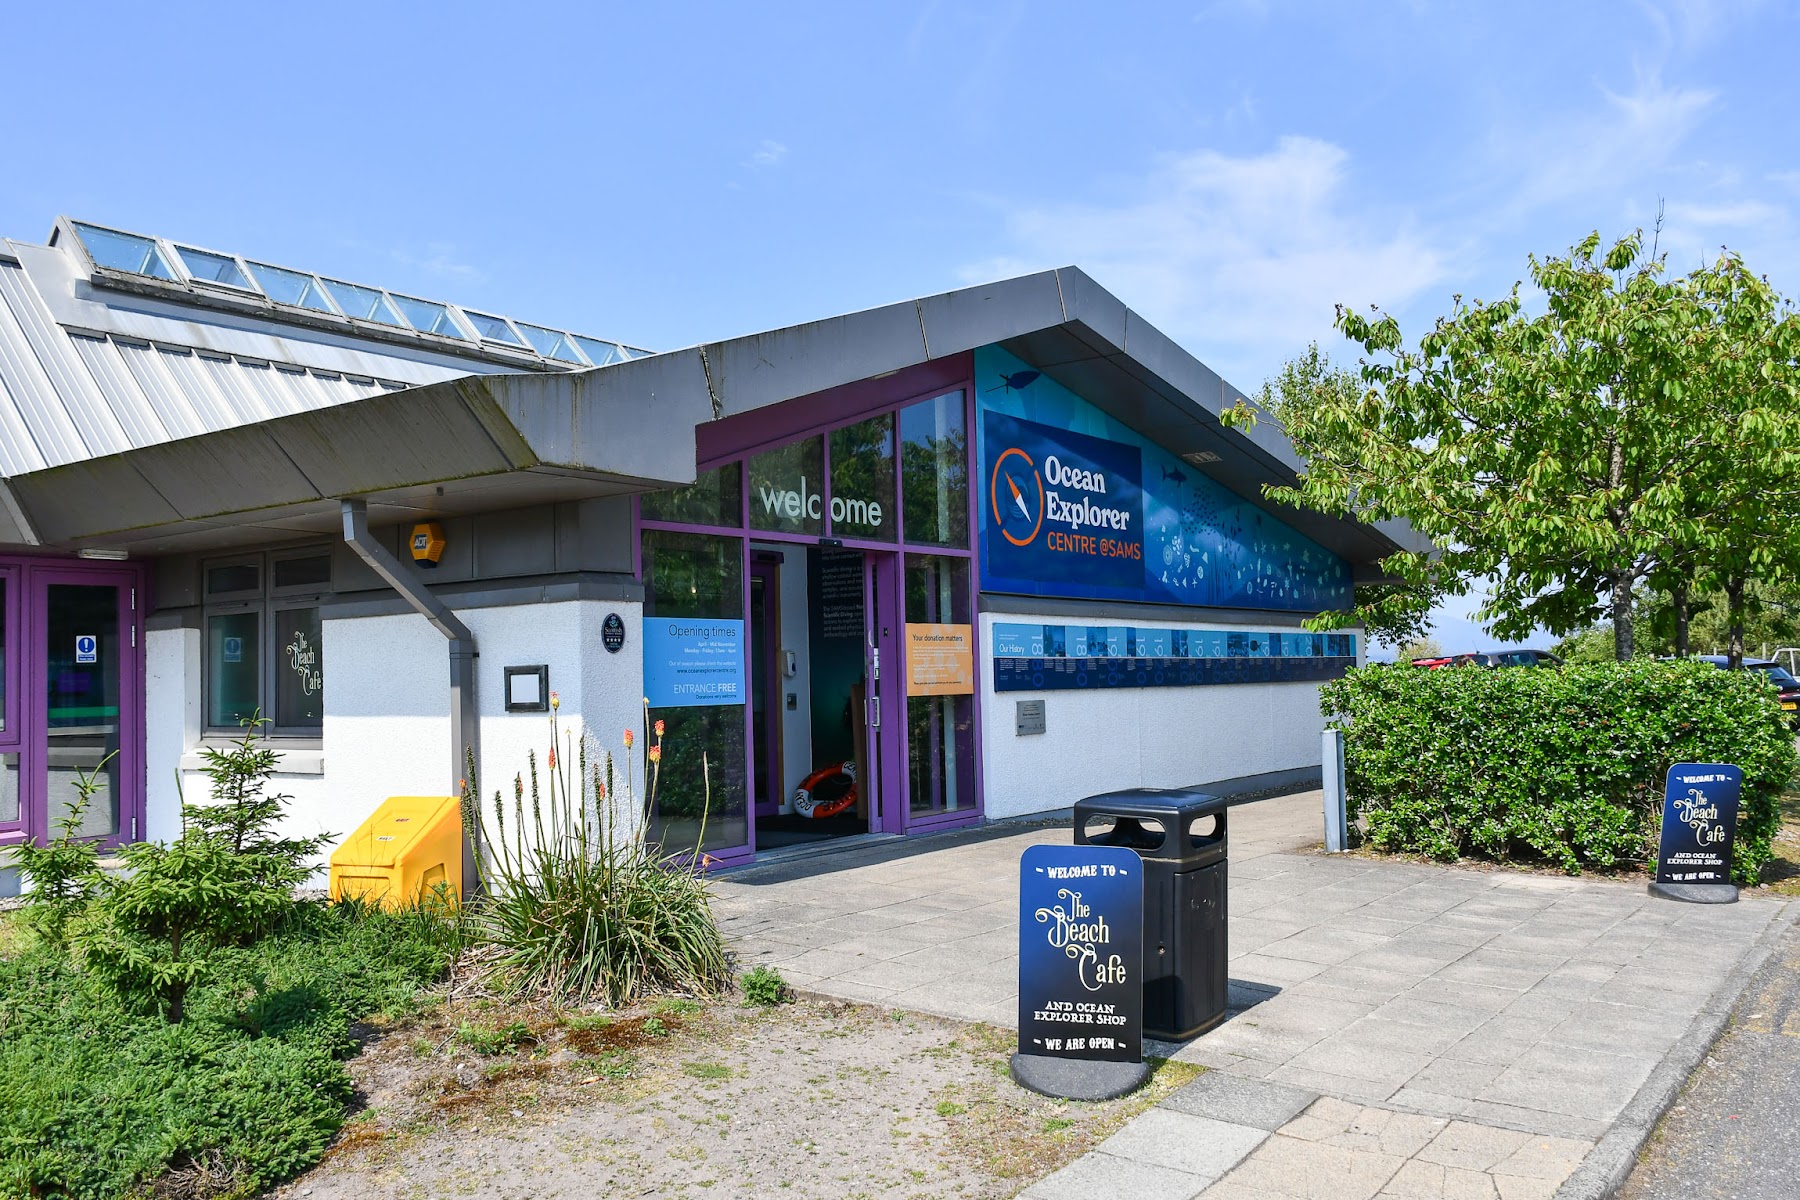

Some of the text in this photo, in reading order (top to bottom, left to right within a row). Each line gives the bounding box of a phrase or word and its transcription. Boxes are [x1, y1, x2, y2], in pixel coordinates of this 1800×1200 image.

[1045, 455, 1106, 494] Ocean
[760, 476, 882, 526] welcome
[1046, 491, 1130, 530] Explorer
[414, 537, 427, 547] ADT
[1048, 531, 1141, 560] CENTRE @SAMS
[295, 631, 307, 652] The
[668, 624, 736, 639] Opening times
[924, 634, 944, 642] donation
[286, 642, 315, 670] Beach
[999, 643, 1008, 653] Our
[298, 665, 322, 695] Cafe
[673, 683, 736, 693] ENTRANCE FREE
[1683, 775, 1714, 783] WELCOME
[1688, 788, 1707, 807] The
[1673, 798, 1717, 822] Beach
[1689, 819, 1725, 847] Cafe
[1047, 865, 1116, 879] WELCOME TO
[1672, 873, 1682, 881] WE
[1057, 888, 1091, 922] The
[1035, 905, 1109, 947] Beach
[1065, 943, 1126, 991] Cafe
[1044, 1000, 1115, 1014] AND OCEAN
[1034, 1011, 1126, 1026] EXPLORER SHOP
[1045, 1037, 1114, 1051] WE ARE OPEN
